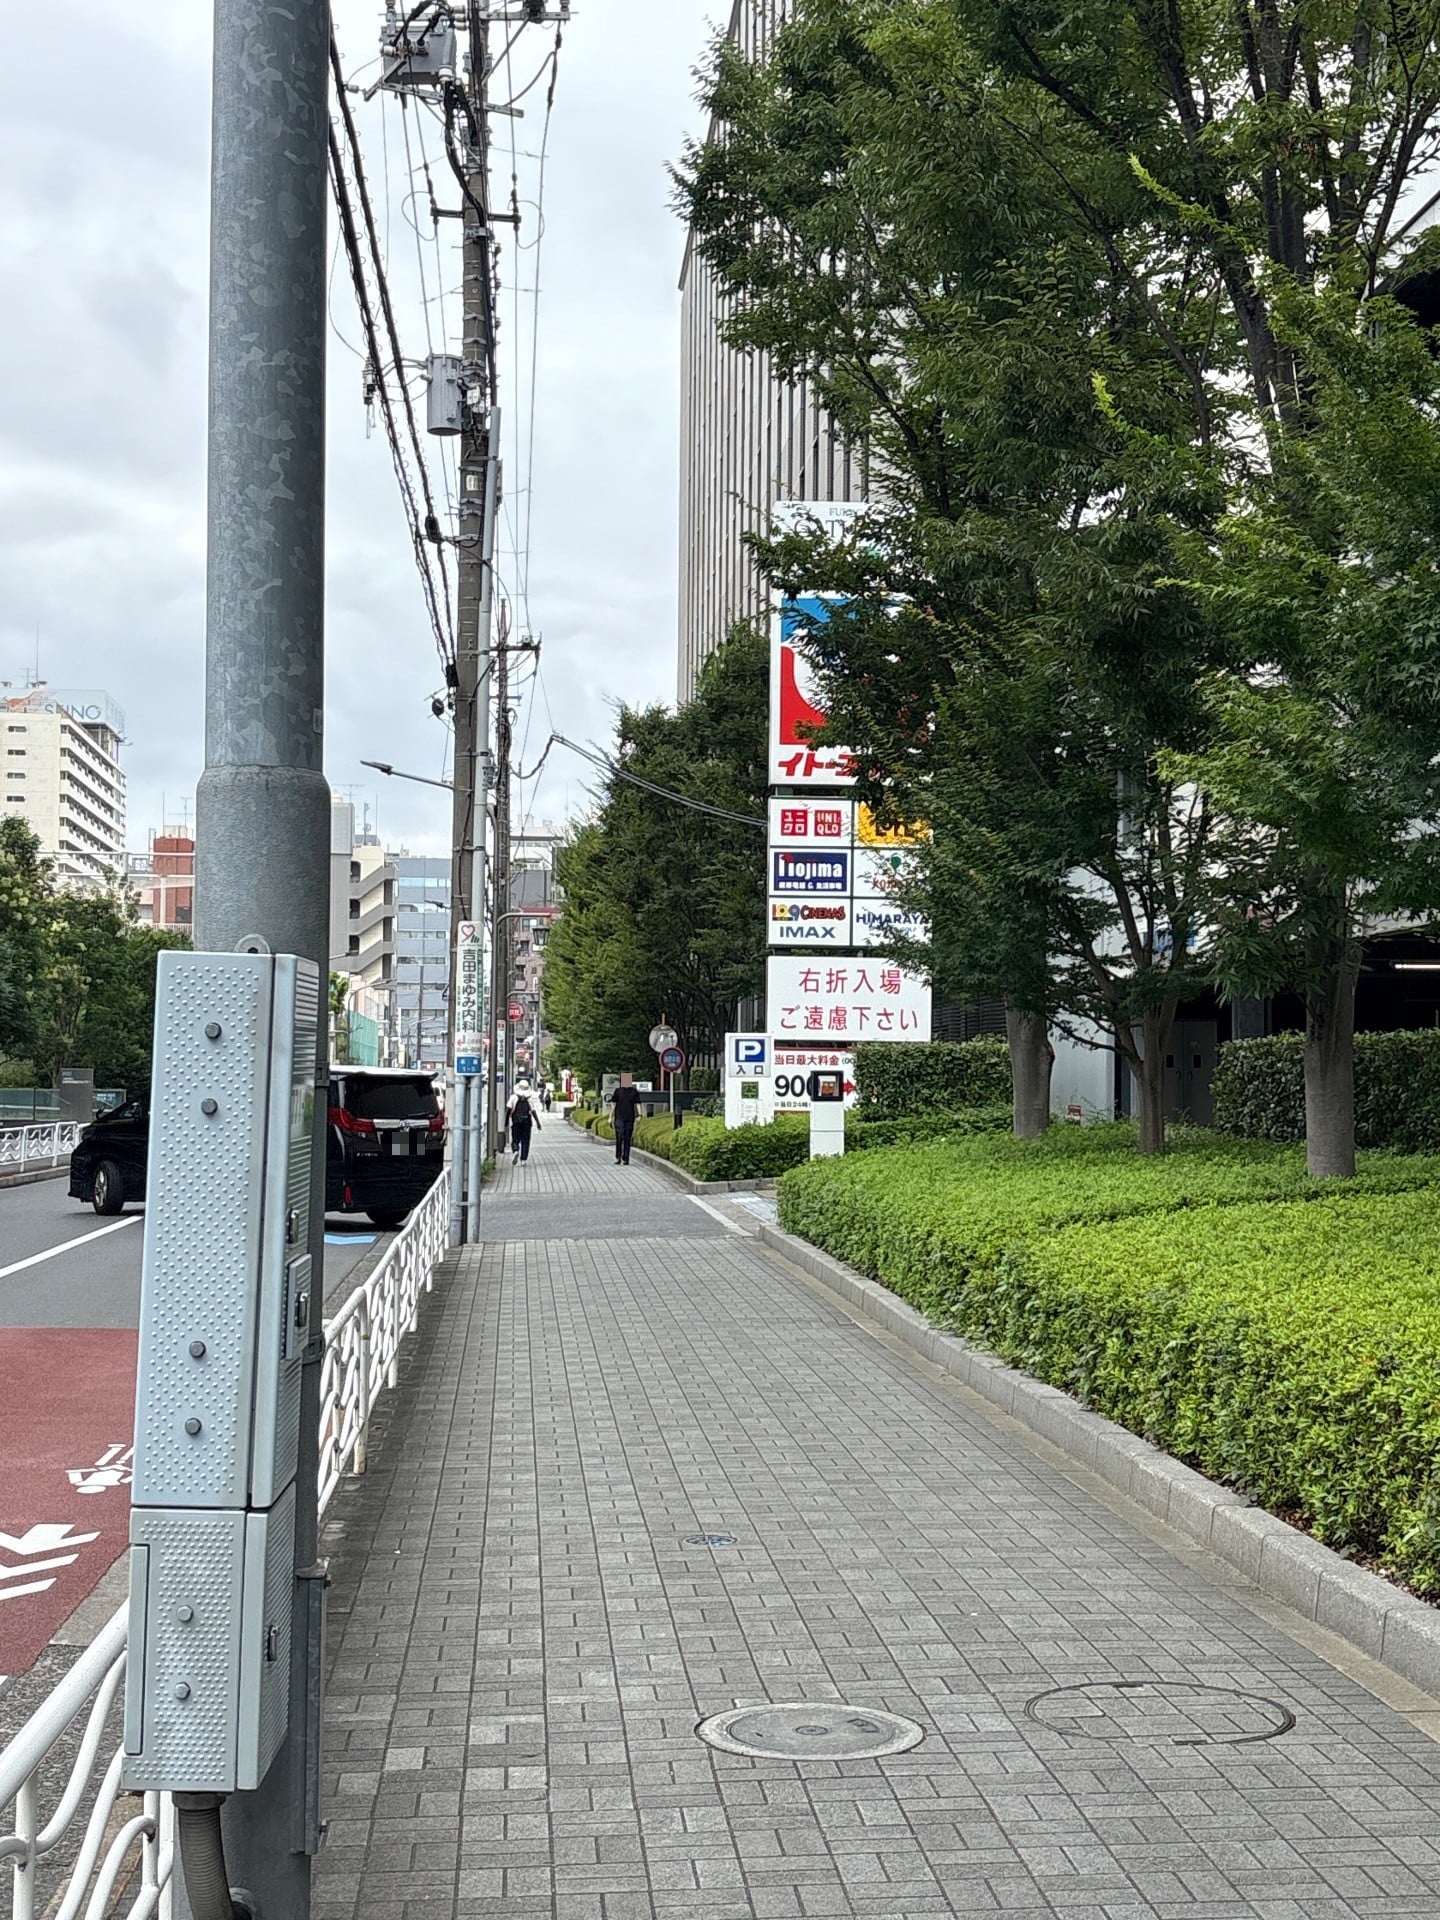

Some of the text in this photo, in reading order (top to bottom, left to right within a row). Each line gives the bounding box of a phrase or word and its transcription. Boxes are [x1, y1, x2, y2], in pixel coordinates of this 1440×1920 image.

[855, 911, 929, 926] HIMARAYA
[779, 926, 836, 938] IMAX
[798, 967, 902, 995] 右折入場
[462, 949, 476, 1033] 吉田まゆみ内科
[780, 1004, 918, 1031] ご遠慮下さい
[738, 1040, 762, 1061] P
[774, 1054, 840, 1066] 当日最大料金
[736, 1064, 764, 1075] 入口
